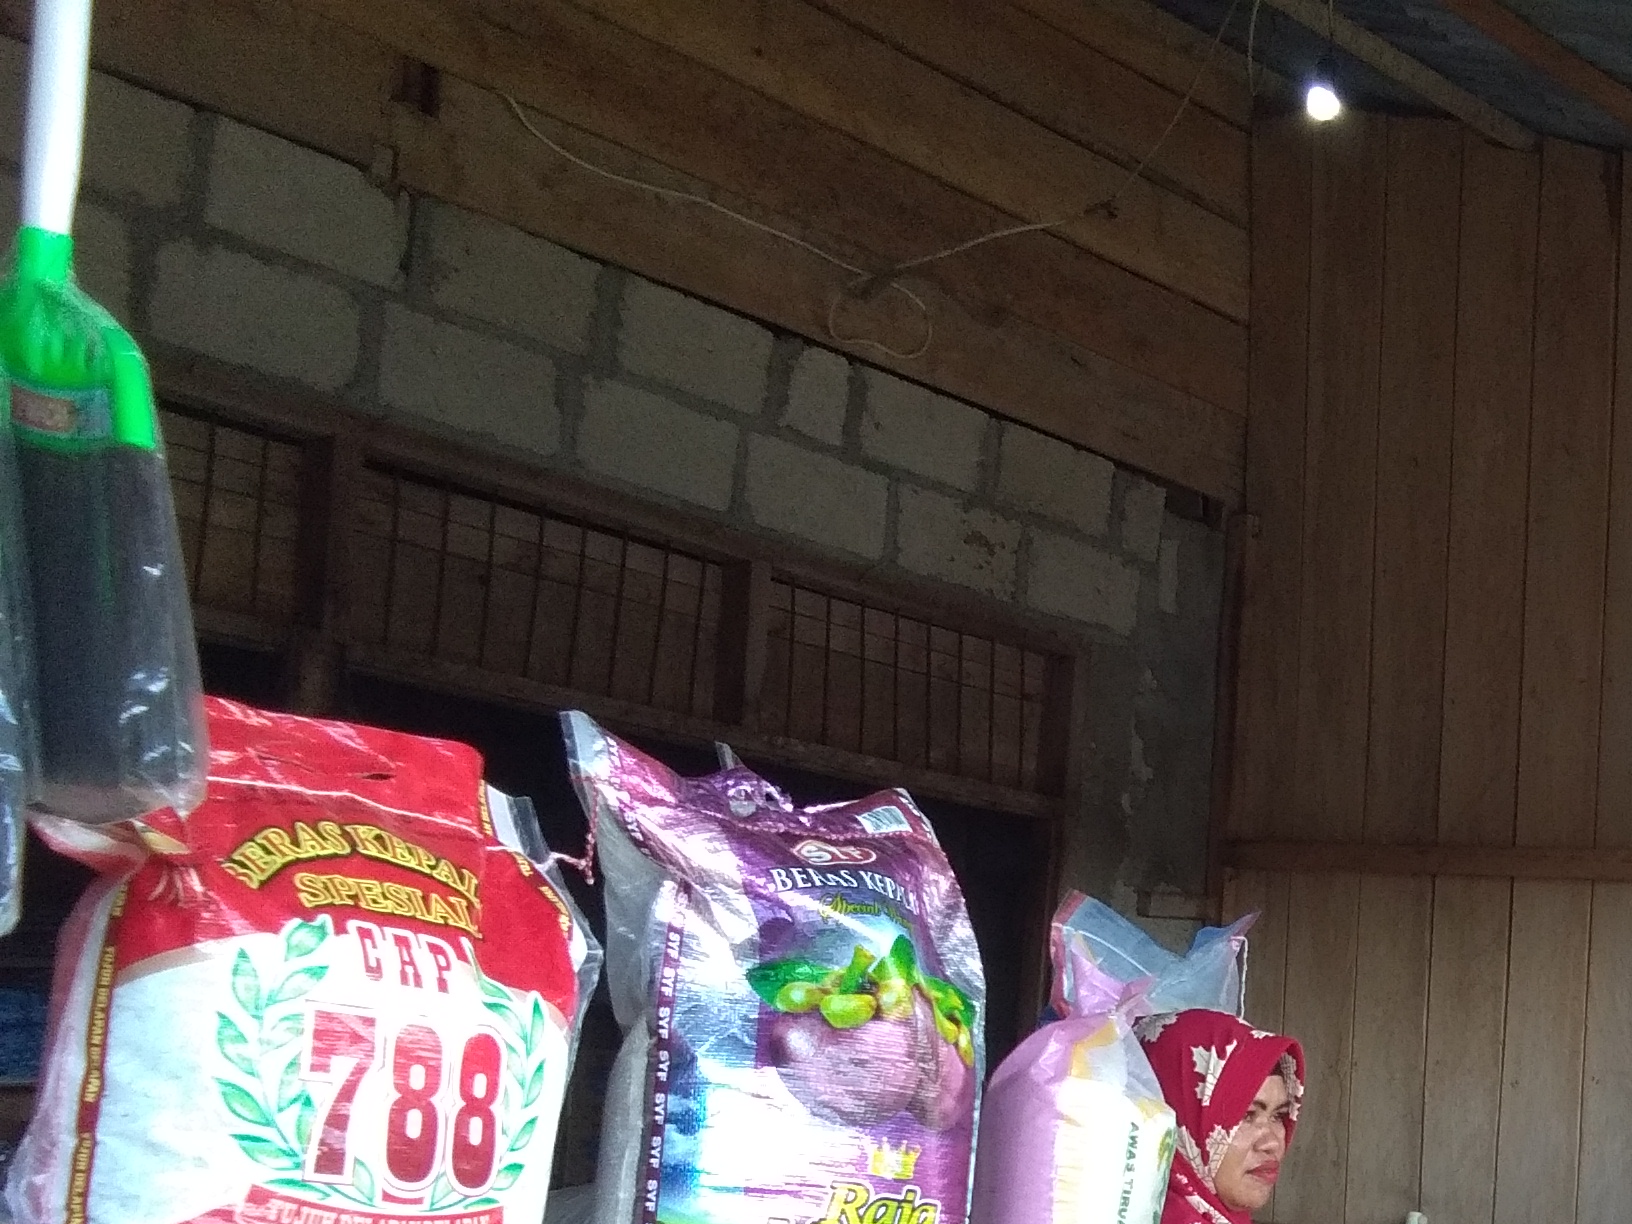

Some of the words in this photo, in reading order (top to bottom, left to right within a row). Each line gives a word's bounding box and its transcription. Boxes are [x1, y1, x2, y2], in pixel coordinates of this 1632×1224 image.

[220, 820, 352, 890] BERAS
[345, 823, 482, 910] KEPAL
[768, 866, 859, 893] BERAS
[293, 871, 484, 940] SPESIAL
[354, 924, 453, 995] CAP
[667, 931, 681, 961] SYF
[660, 966, 677, 997] SYF
[657, 1005, 672, 1040] SYF
[655, 1049, 671, 1082] SYF
[306, 1006, 504, 1190] 788
[653, 1092, 668, 1126] SYF
[649, 1135, 663, 1169] SYF
[1123, 1120, 1140, 1175] AWAS
[644, 1179, 659, 1212] SYF
